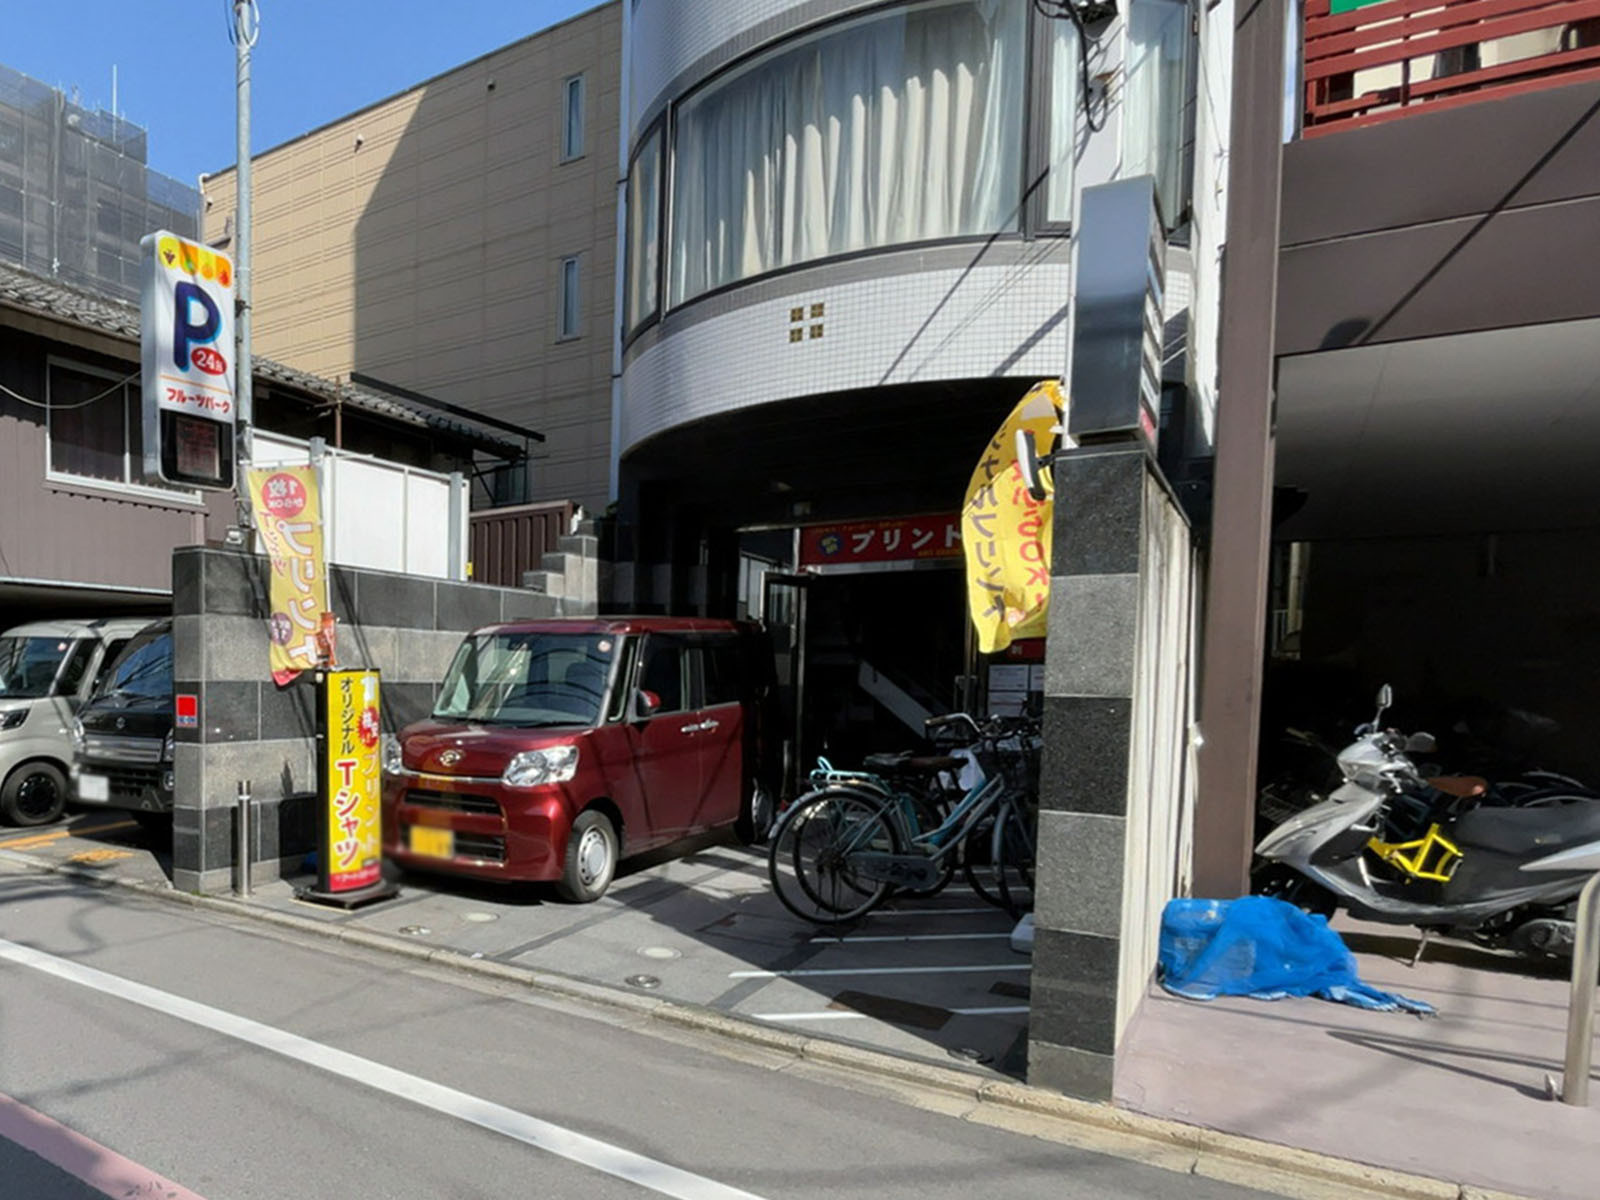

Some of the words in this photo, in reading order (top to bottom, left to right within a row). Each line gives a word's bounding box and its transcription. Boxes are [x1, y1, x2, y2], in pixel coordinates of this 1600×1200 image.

[174, 280, 222, 372] P
[166, 387, 230, 414] フルーツパーク
[852, 525, 962, 554] プリント
[341, 677, 355, 755] オリジナル
[336, 760, 360, 867] Tシャツ
